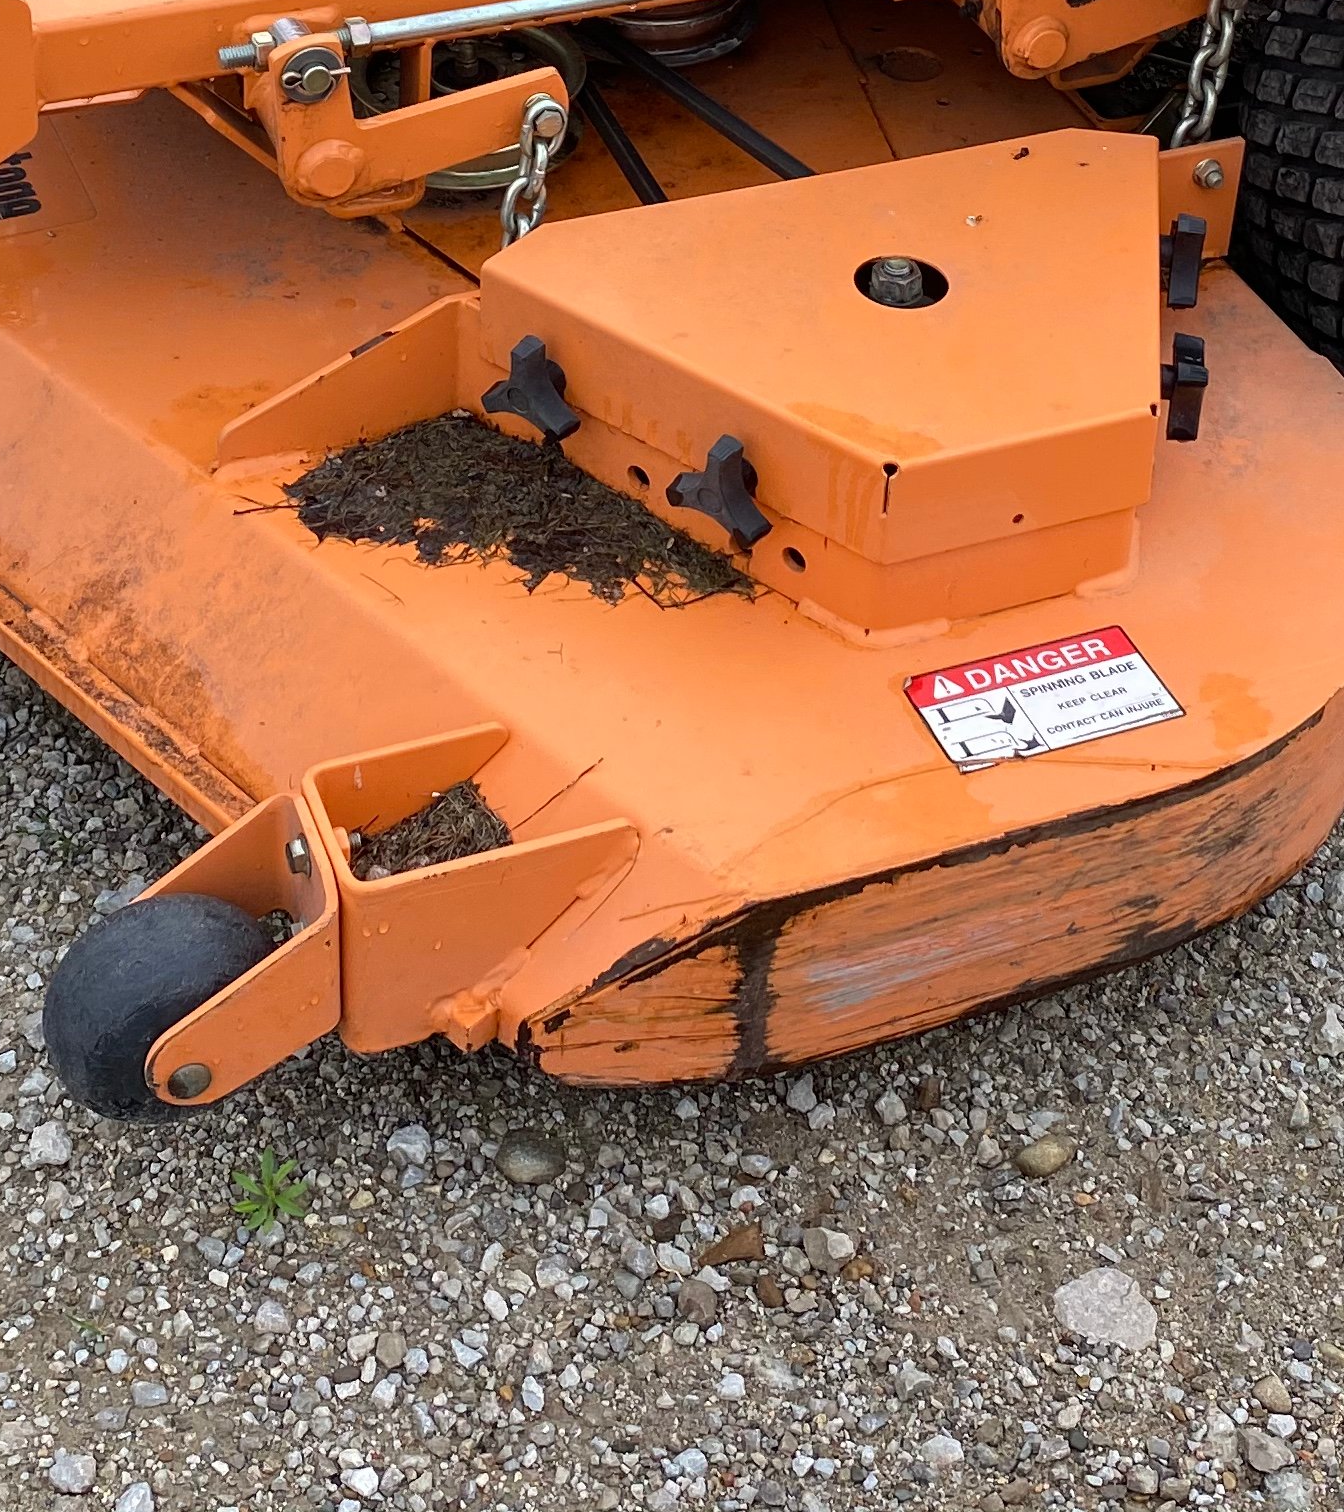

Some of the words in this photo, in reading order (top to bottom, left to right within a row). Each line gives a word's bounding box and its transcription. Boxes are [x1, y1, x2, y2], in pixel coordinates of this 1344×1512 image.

[966, 638, 1112, 690] DANGER
[1020, 674, 1087, 698] SPINNING
[1089, 661, 1138, 680] BLADE
[1047, 716, 1097, 735] CONTACT
[1100, 708, 1124, 720] CAN
[1126, 698, 1165, 714] INJURE
[1057, 696, 1087, 710] KEEP
[1090, 687, 1128, 702] CLEAR
